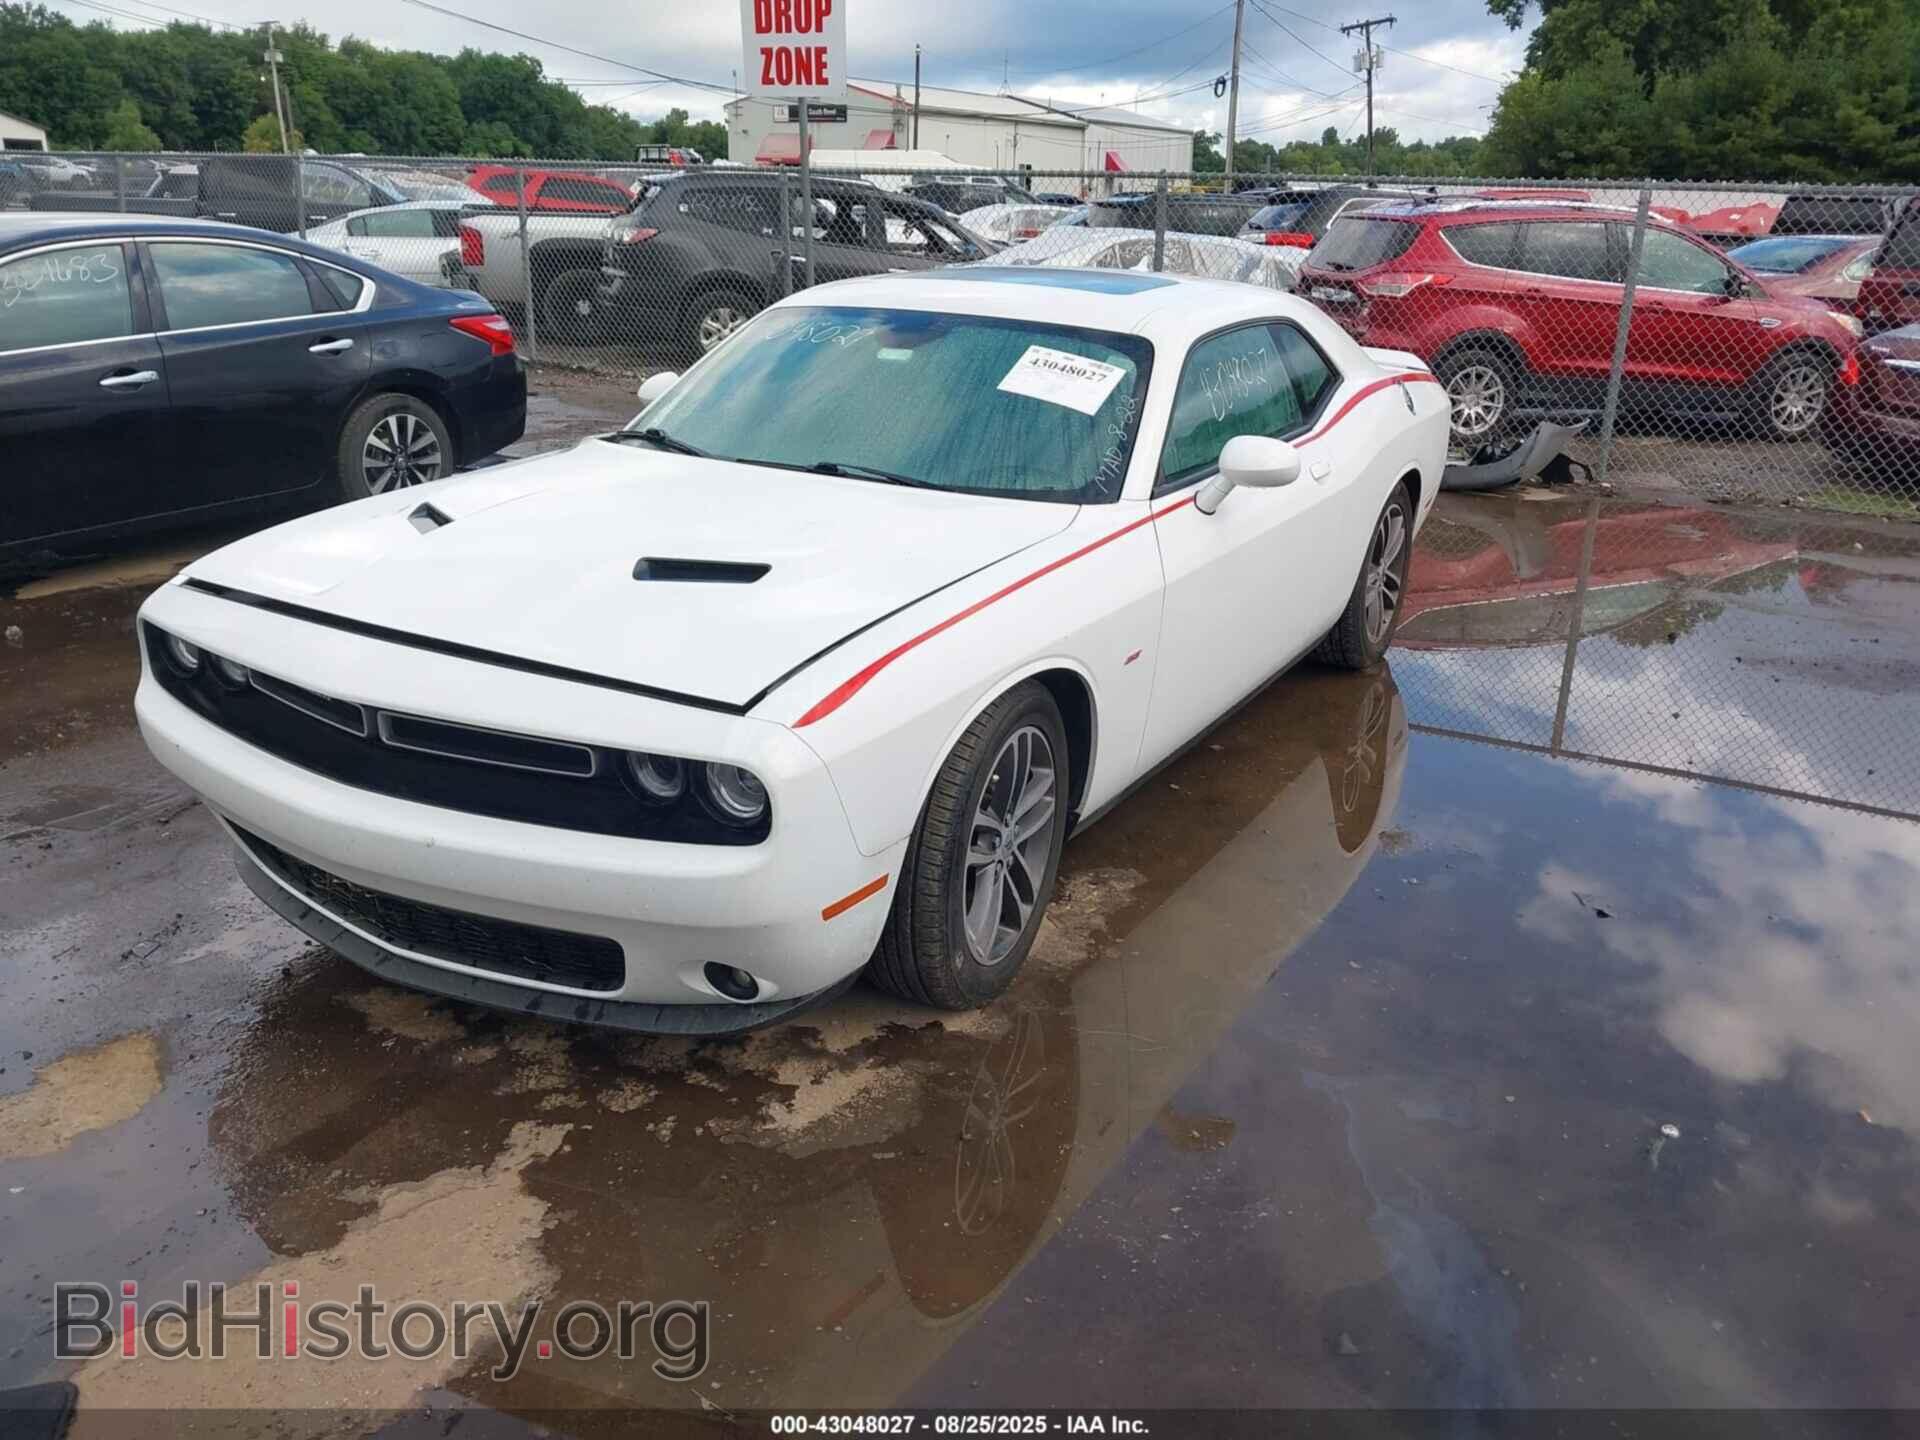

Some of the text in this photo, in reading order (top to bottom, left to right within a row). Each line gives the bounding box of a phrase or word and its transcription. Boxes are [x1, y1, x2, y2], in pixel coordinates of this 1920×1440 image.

[754, 0, 832, 34] DROP
[760, 46, 829, 86] ZONE
[1029, 357, 1107, 383] 43048027
